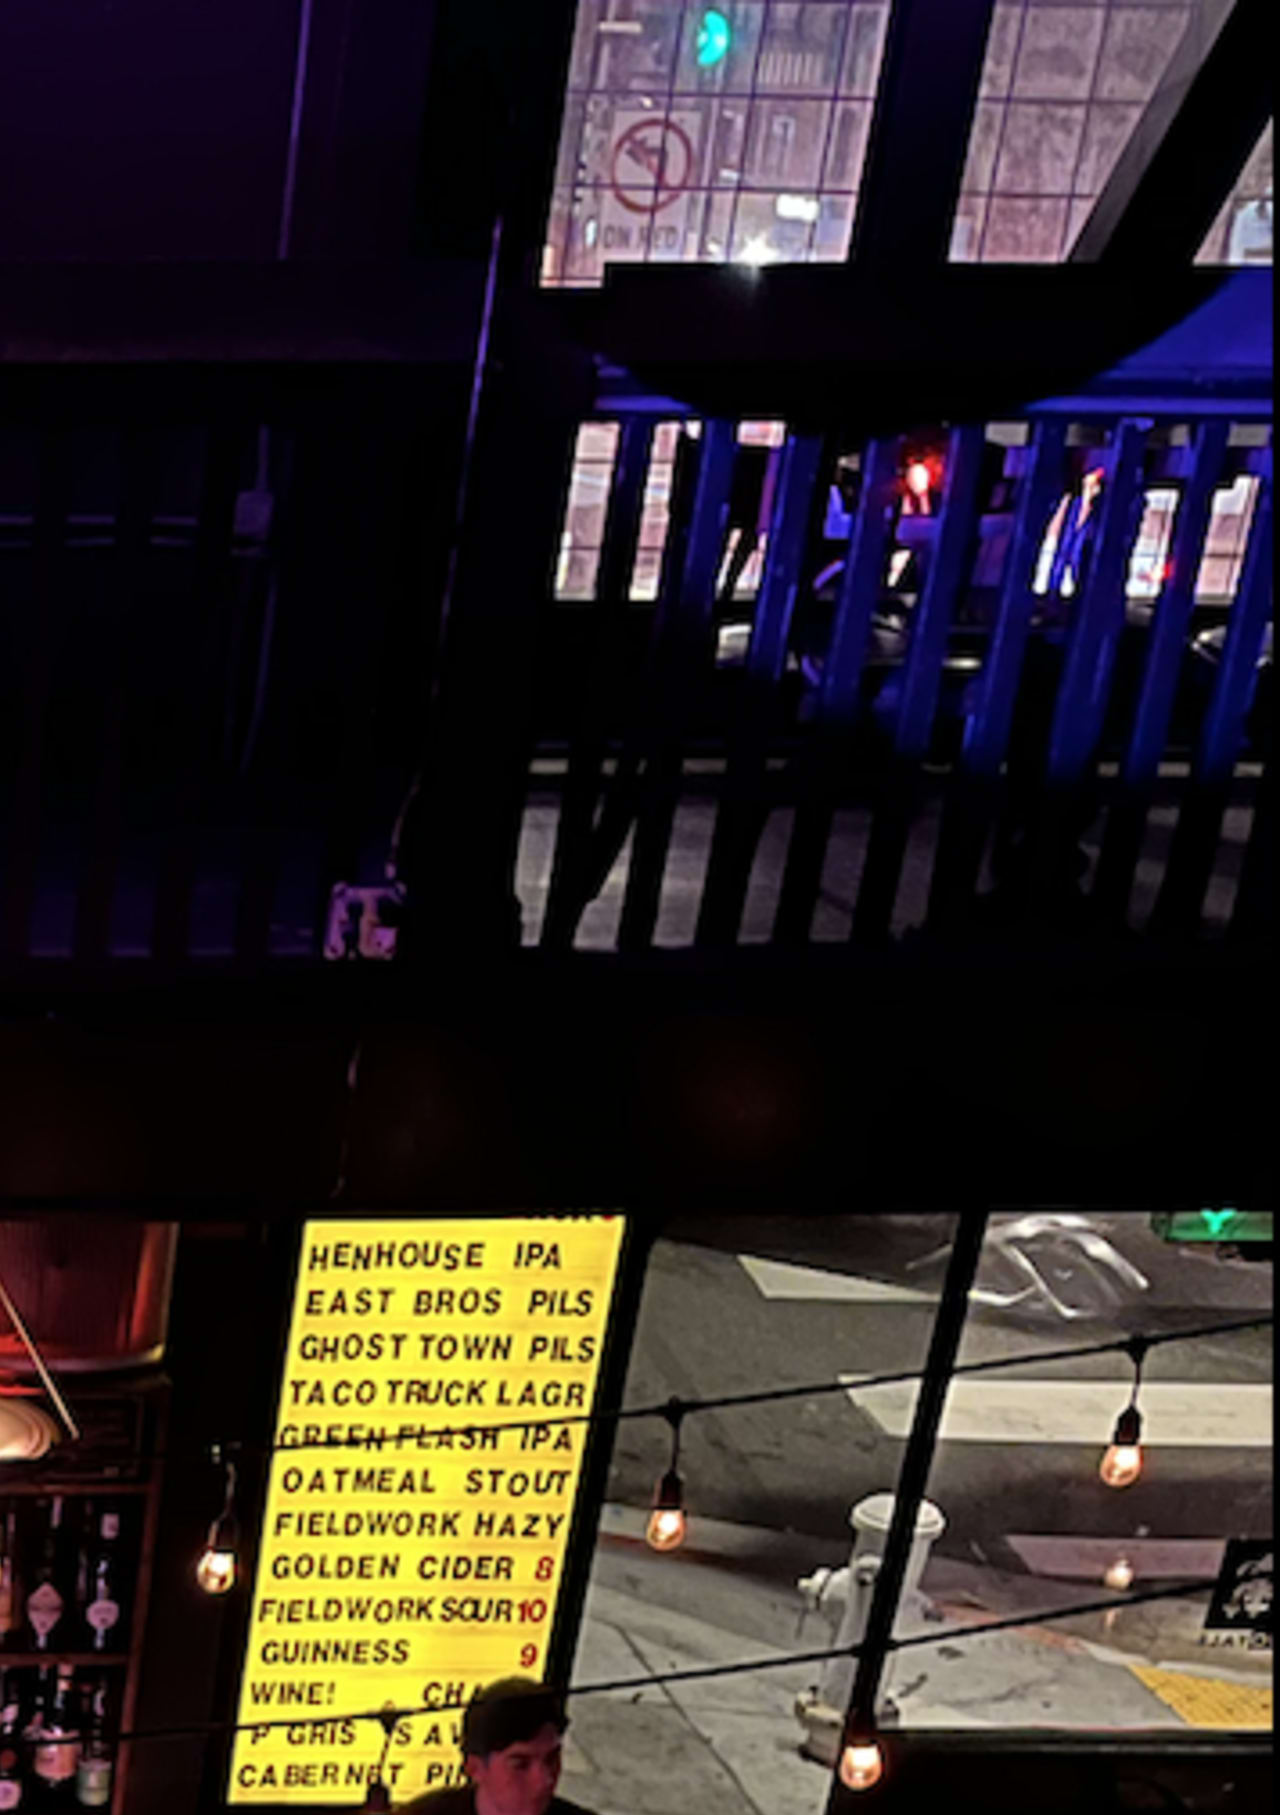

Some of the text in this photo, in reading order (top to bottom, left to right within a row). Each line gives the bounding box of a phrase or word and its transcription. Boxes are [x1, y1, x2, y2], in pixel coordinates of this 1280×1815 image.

[308, 1241, 561, 1271] HENHOUSE IPA
[304, 1289, 594, 1317] EAST BROS PILS
[299, 1333, 596, 1364] GHOST TOWN PILS
[290, 1379, 586, 1408] TACO TRUCK LAGR
[280, 1424, 573, 1451] GREEN FLASH IPA
[282, 1467, 572, 1497] OATMEAL STOUT
[274, 1511, 565, 1539] FIELDWORK HAZY
[271, 1553, 555, 1582] GOLDEN CIDER 8
[257, 1597, 548, 1624] FIELDWORK SOUR 10
[260, 1639, 538, 1669] GUINNESS 9
[251, 1681, 336, 1706] WINE!
[286, 1719, 357, 1745] GRIS
[237, 1763, 404, 1788] CABERNET
